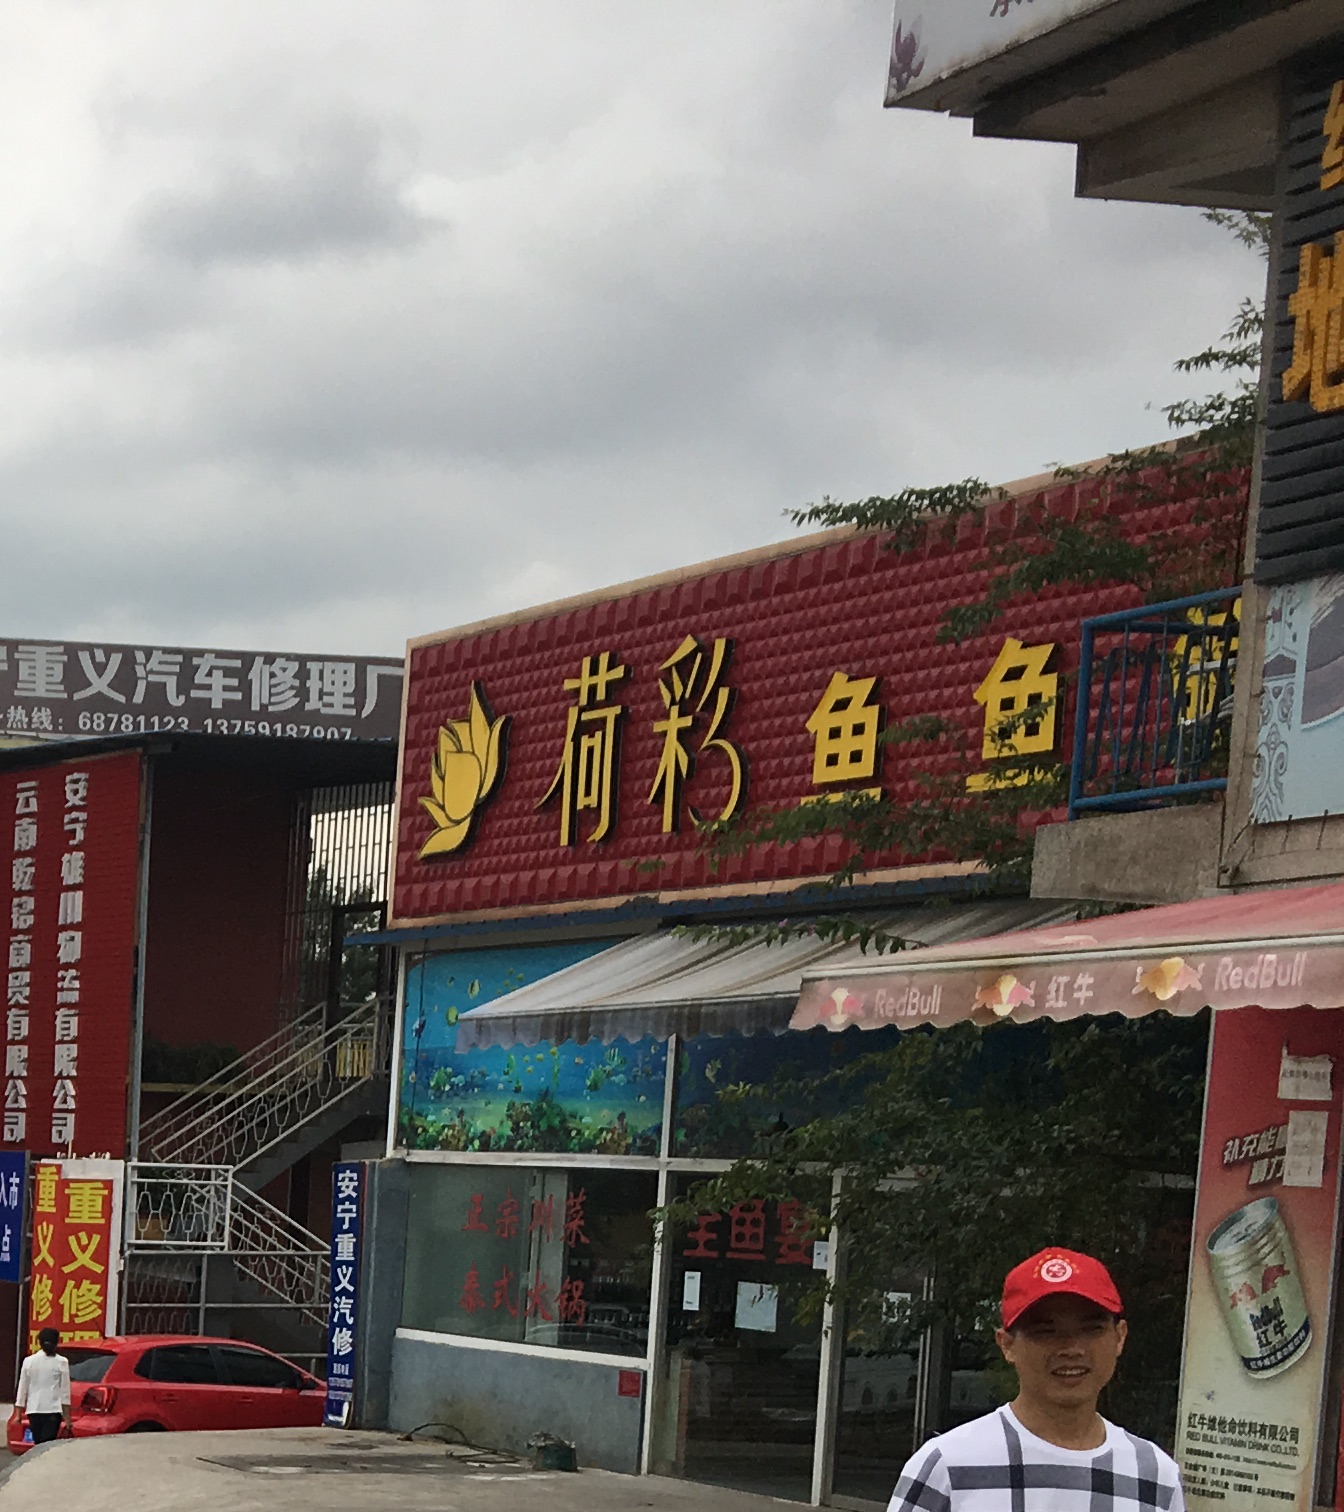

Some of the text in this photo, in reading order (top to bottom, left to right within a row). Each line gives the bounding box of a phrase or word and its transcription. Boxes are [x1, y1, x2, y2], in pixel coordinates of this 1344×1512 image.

[1046, 972, 1095, 1009] 红牛
[1214, 952, 1308, 991] RedBull
[462, 1188, 590, 1248] 正宗川菜
[59, 1182, 109, 1343] 重义修
[332, 1169, 359, 1356] 安宁重义汽修
[1187, 1411, 1300, 1445] 红牛维他命饮料有限公司
